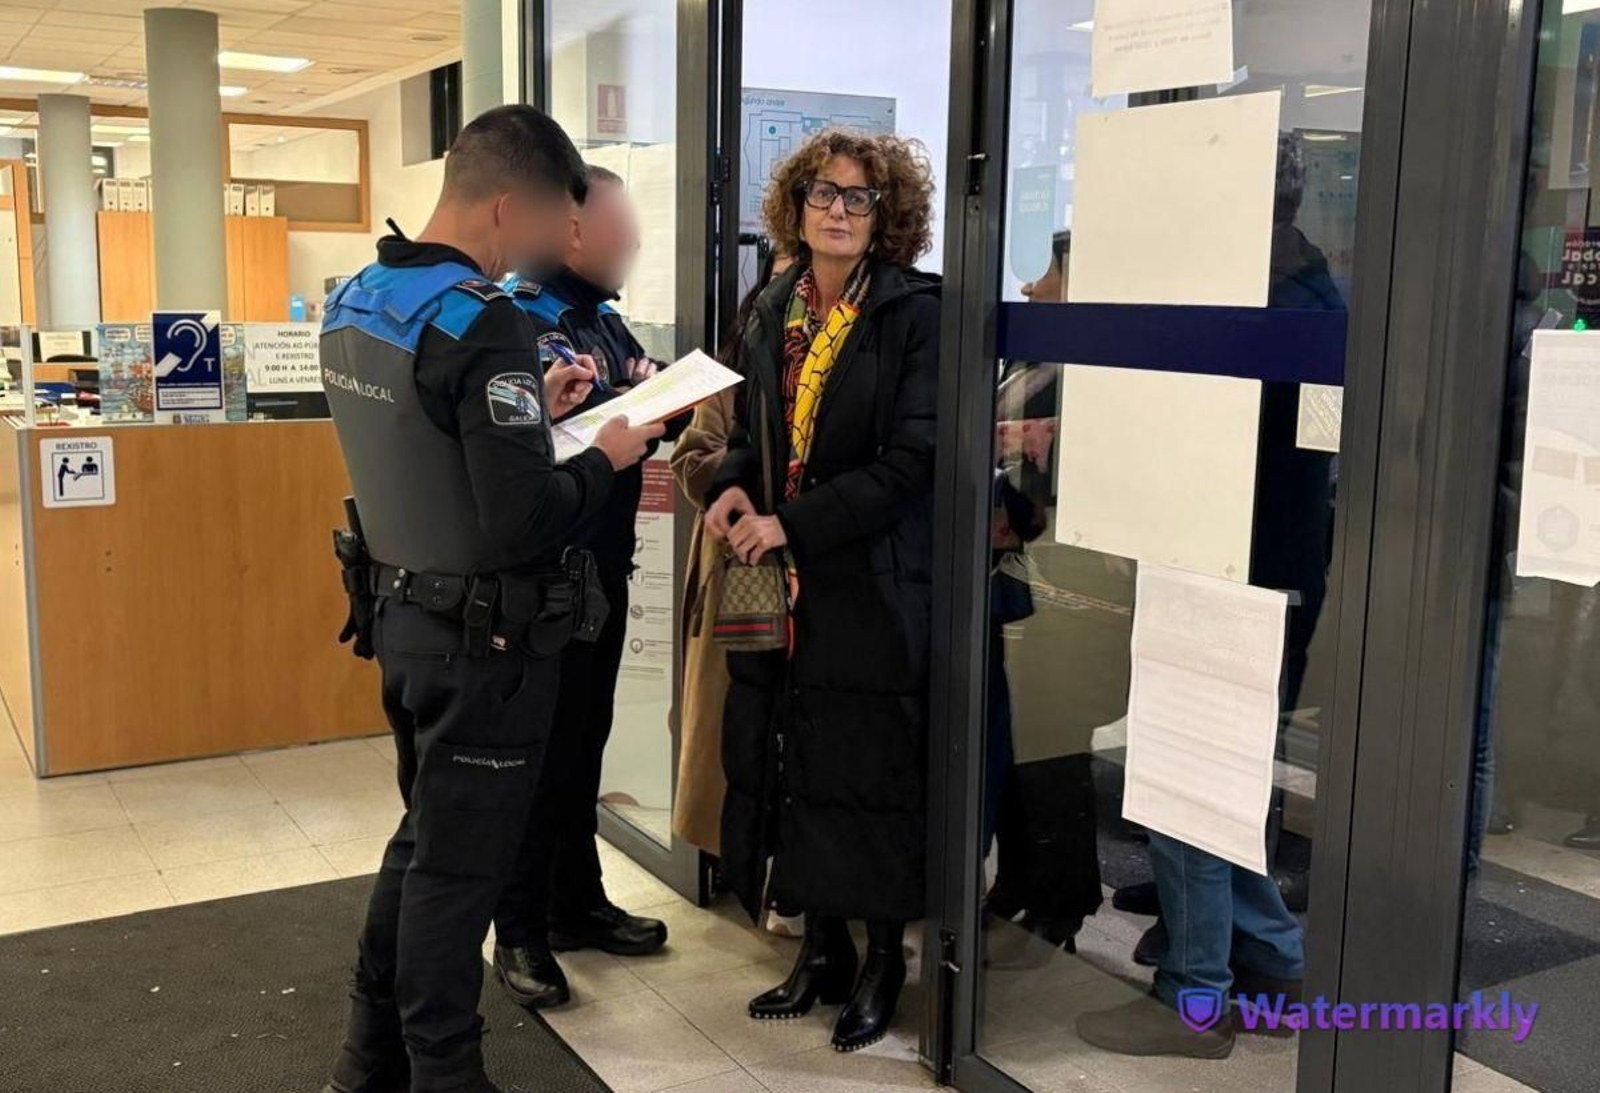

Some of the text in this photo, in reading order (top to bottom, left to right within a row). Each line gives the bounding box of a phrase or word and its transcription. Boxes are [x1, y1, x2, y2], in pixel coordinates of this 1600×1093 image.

[277, 330, 311, 338] HORARIO
[255, 341, 291, 349] ATENCIÓN
[281, 352, 314, 360] REXISTRO
[204, 358, 216, 372] T
[359, 382, 395, 403] LOCAL
[55, 441, 98, 450] REXISTRO
